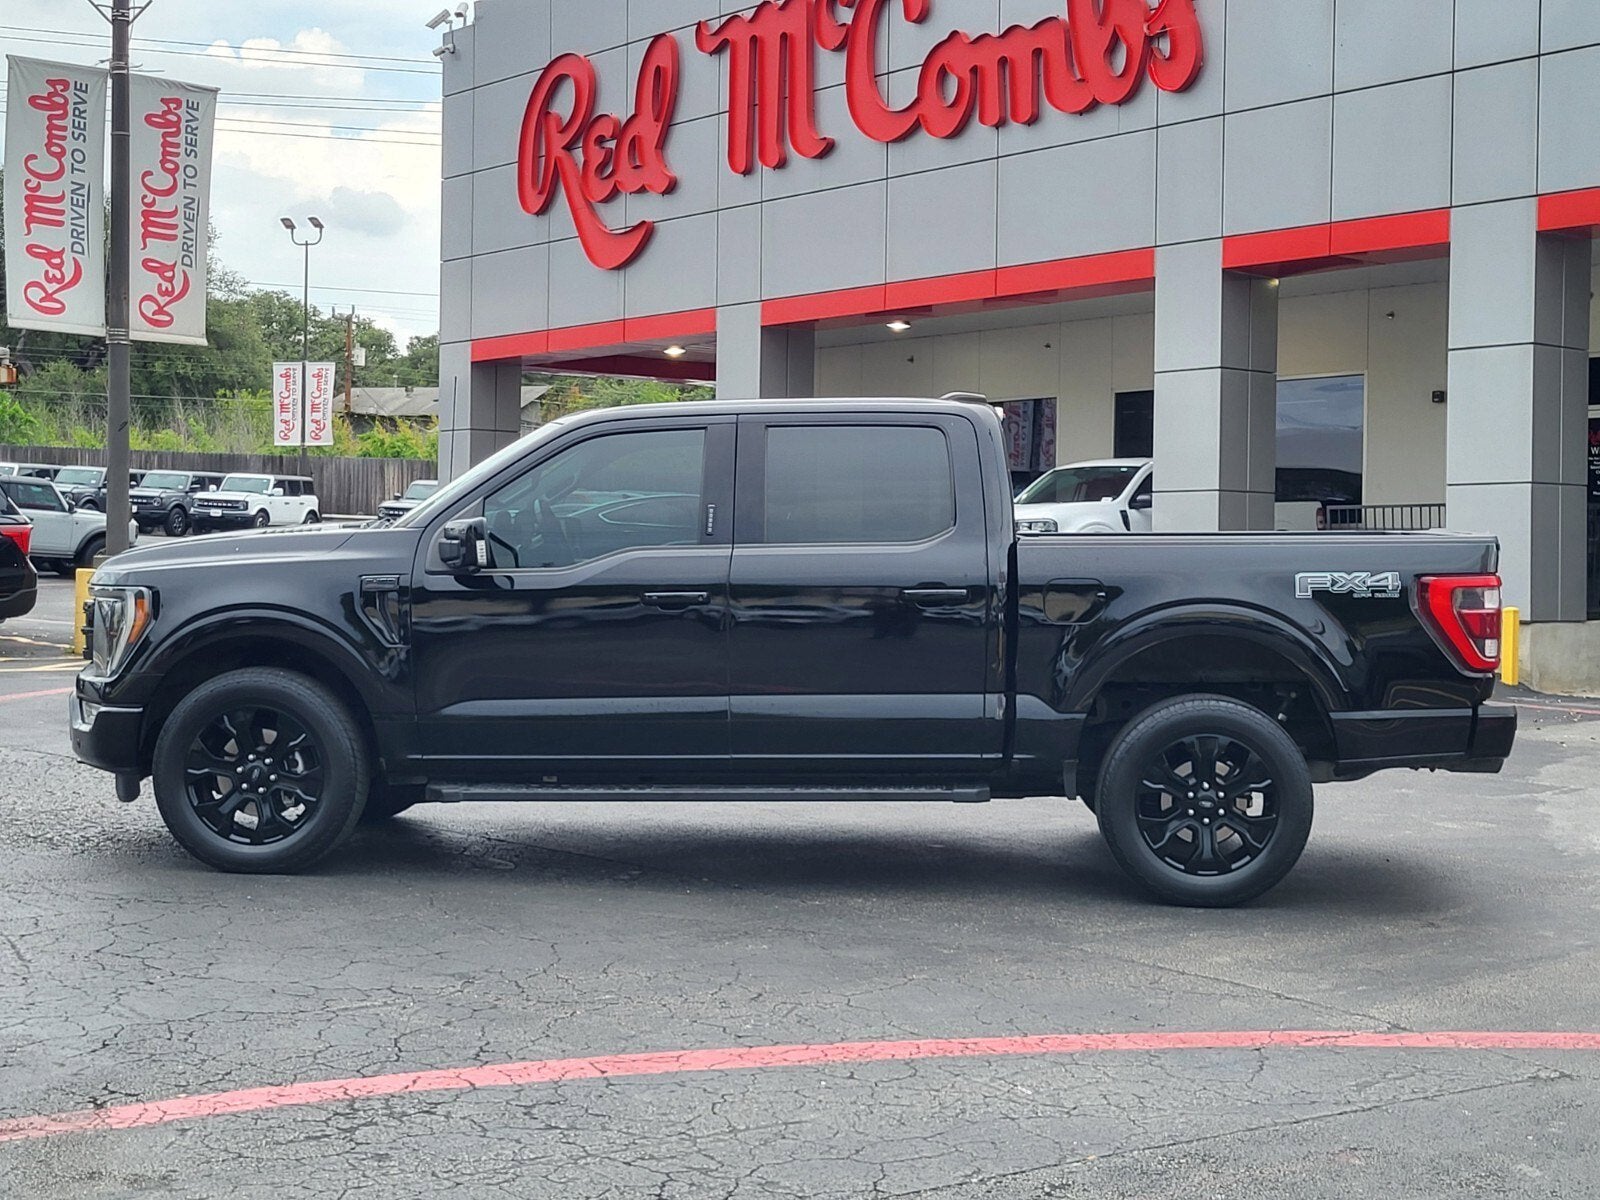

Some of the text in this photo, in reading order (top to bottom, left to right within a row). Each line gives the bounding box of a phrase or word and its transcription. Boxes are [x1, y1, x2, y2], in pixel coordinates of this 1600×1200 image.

[71, 80, 89, 257] DRIVEN TO SERVE
[181, 98, 200, 269] DRIVEN TO SERVE
[517, 0, 1203, 270] Red McCombs
[23, 78, 83, 315] Red McCombs
[138, 96, 190, 328] Red McCombs
[279, 368, 294, 440] Red McCombs
[292, 388, 296, 396] TO
[310, 368, 325, 440] Red McCombs
[323, 388, 328, 396] TO
[1295, 571, 1401, 598] FX4
